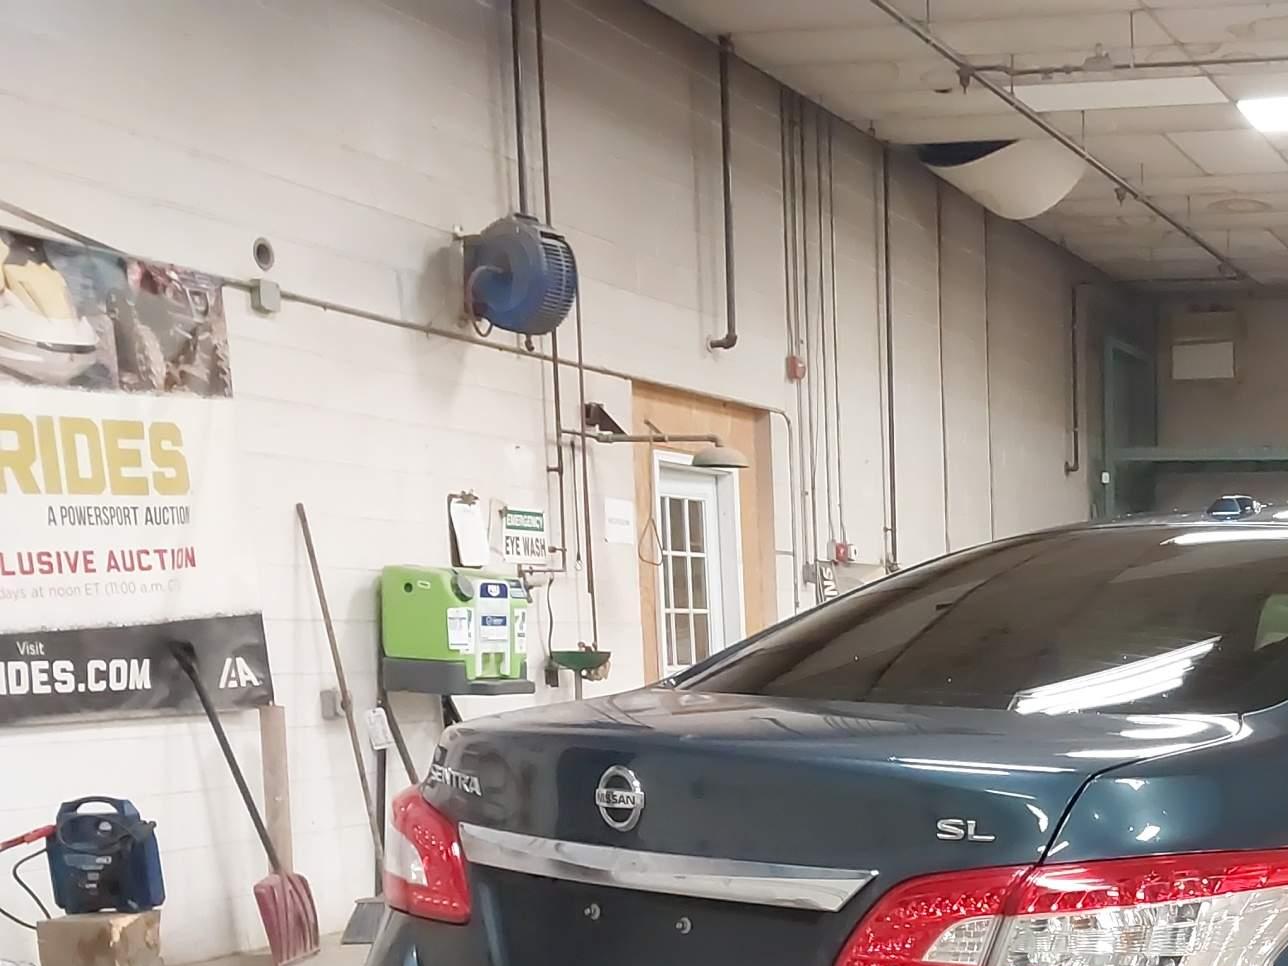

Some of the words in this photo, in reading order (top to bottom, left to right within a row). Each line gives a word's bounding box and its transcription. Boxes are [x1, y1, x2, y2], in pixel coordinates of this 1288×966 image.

[0, 413, 190, 496] RIDES
[47, 505, 57, 526] A
[60, 505, 139, 526] POWERSPORT
[145, 506, 190, 526] AUCTION
[505, 535, 521, 556] EYE
[522, 537, 547, 558] WASH
[0, 550, 96, 576] LUSIVE
[107, 547, 196, 573] AUCTION
[31, 585, 44, 598] at
[48, 585, 81, 597] noon
[84, 582, 101, 596] ET
[16, 641, 45, 656] Visit
[431, 763, 482, 797] SENTRA
[598, 791, 637, 806] NISSAN
[936, 818, 996, 841] SL
